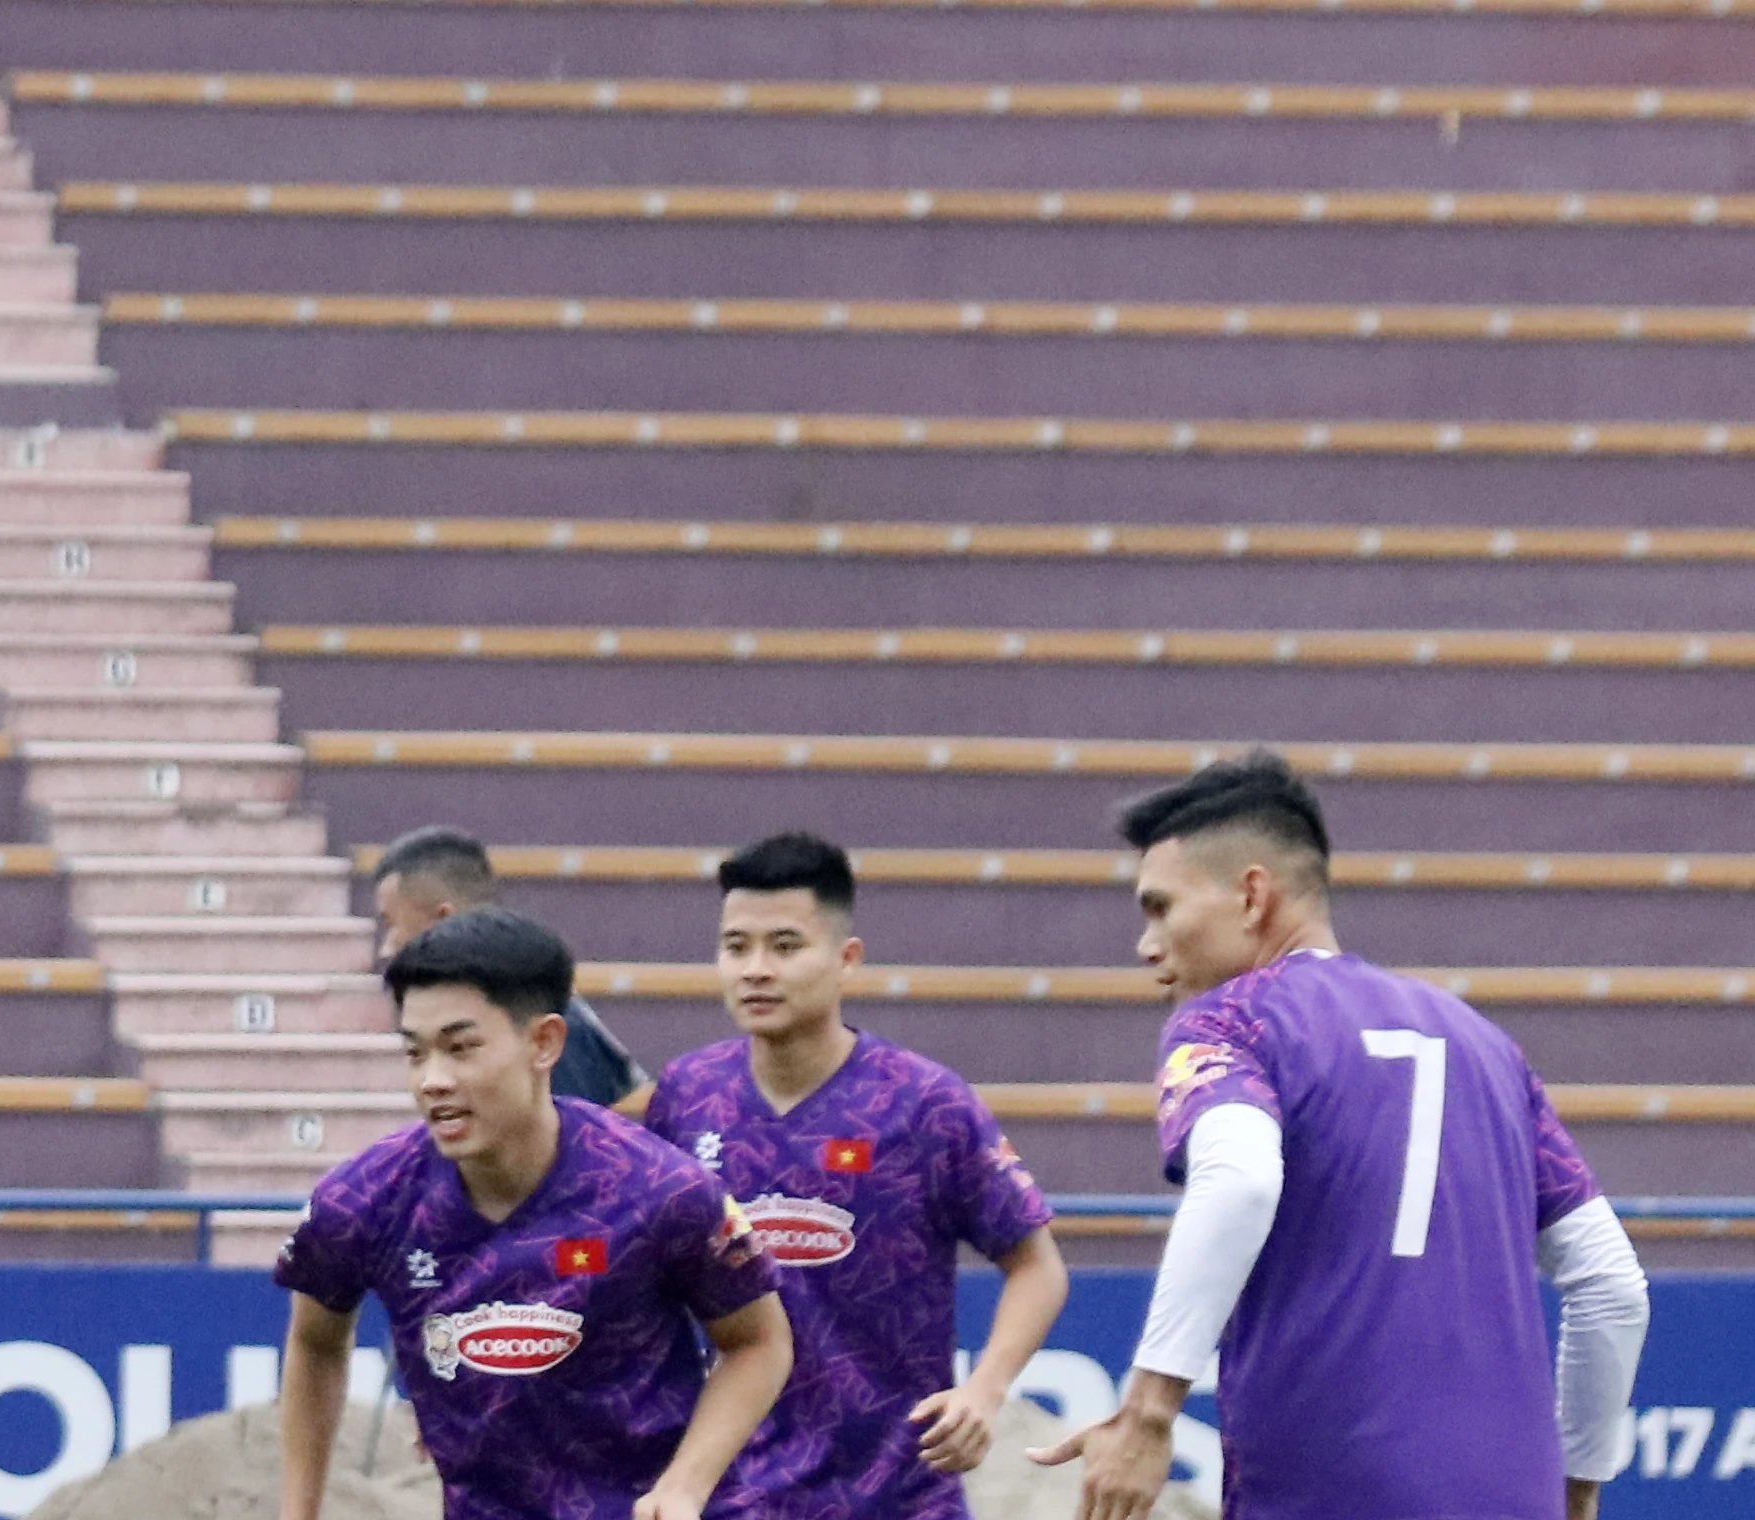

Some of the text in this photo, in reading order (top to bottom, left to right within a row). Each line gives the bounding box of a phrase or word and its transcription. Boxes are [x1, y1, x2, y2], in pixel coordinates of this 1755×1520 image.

[1360, 1029, 1446, 1257] 7
[453, 1305, 582, 1330] Cook happiness
